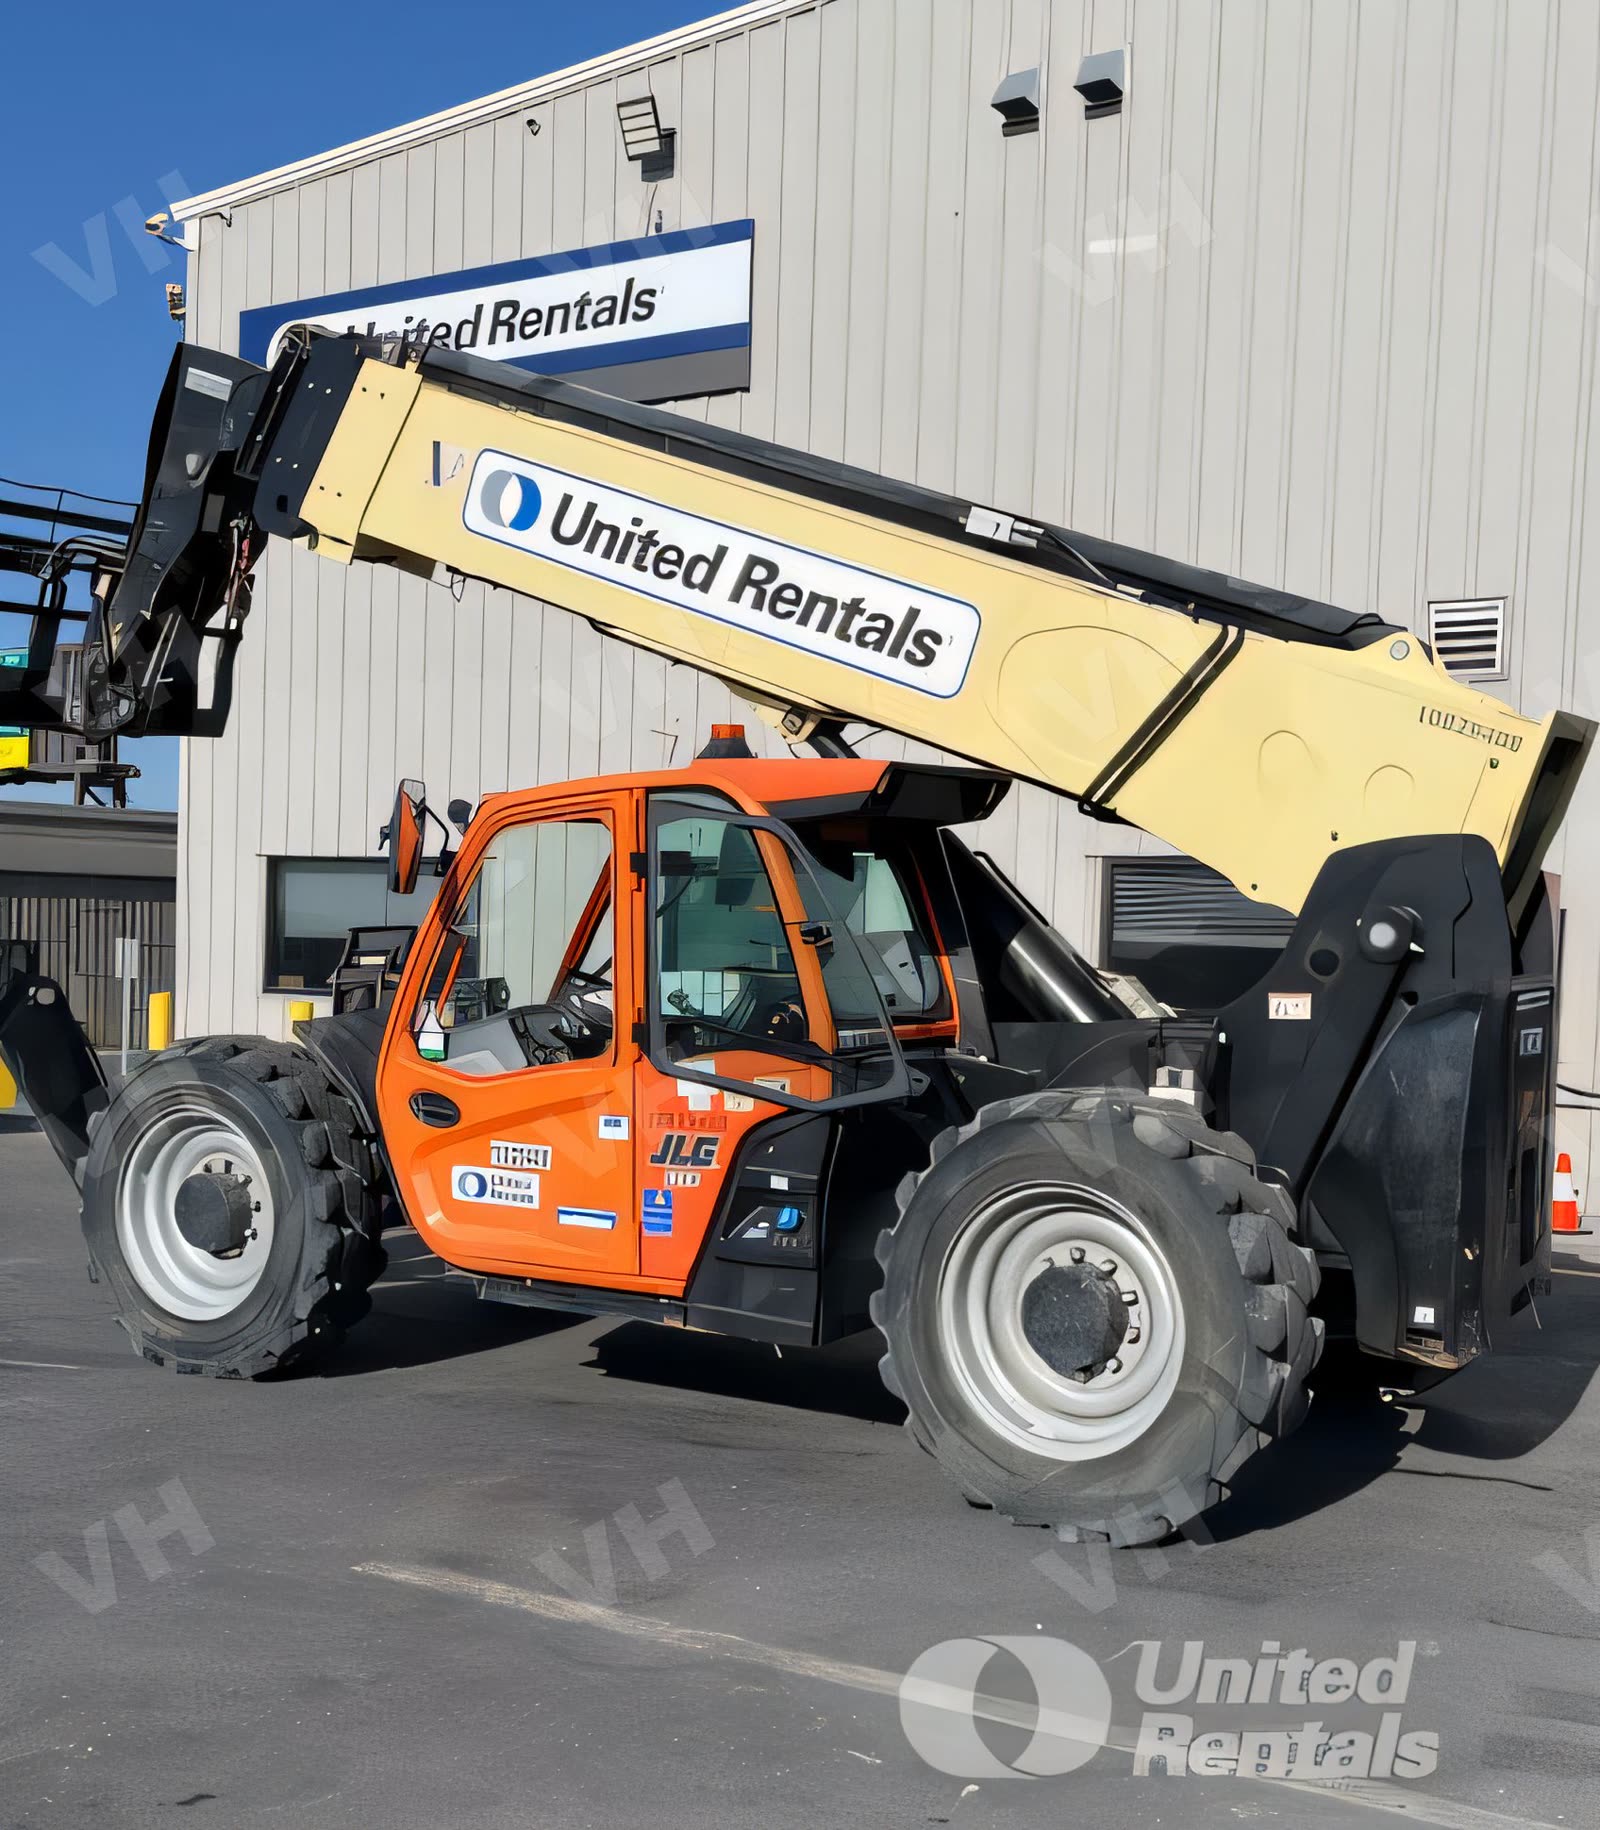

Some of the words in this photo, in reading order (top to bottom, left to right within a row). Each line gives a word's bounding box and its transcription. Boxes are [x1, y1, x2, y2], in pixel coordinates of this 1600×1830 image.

[488, 277, 657, 345] Rentals
[550, 493, 729, 595] United
[727, 552, 944, 668] Rentals
[650, 1133, 720, 1167] JLG
